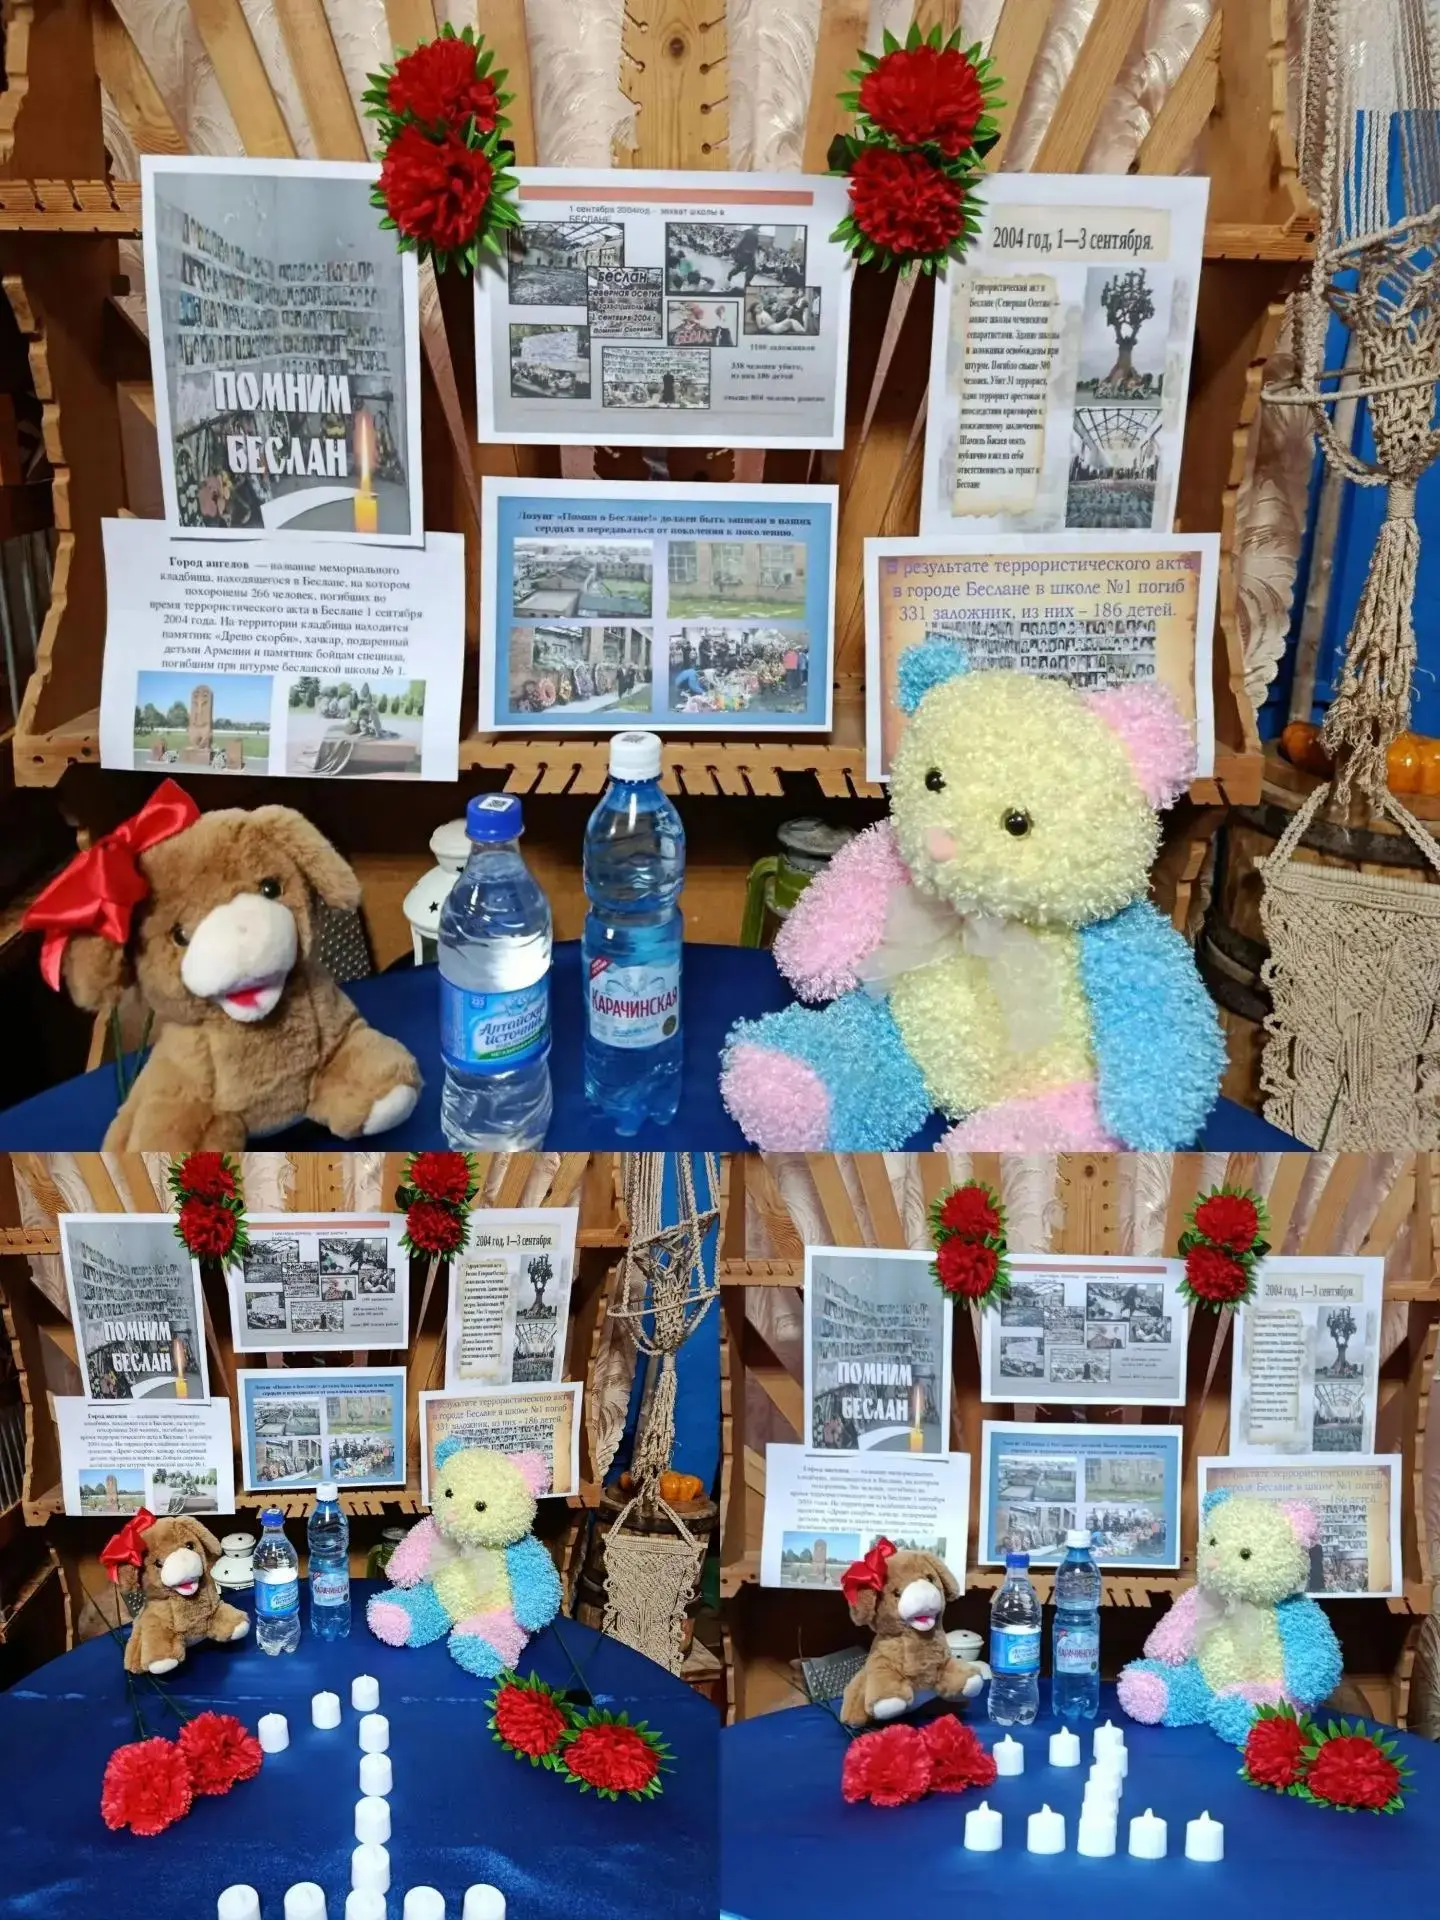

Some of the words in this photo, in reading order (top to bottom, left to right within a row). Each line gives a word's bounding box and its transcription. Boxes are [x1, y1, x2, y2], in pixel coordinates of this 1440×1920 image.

[993, 226, 1024, 249] 2004
[1027, 231, 1053, 252] год,
[1090, 228, 1154, 256] сентября.
[212, 370, 351, 415] ПОМНИМ
[226, 433, 348, 478] БЕСЛАН
[169, 556, 204, 570] Город
[206, 560, 250, 570] ангелов
[270, 562, 317, 572] название
[319, 564, 400, 576] мемориального
[903, 561, 990, 578] результате
[994, 558, 1151, 577] террористического
[1155, 558, 1196, 572] акта
[217, 575, 291, 586] находящегося
[351, 580, 363, 588] на
[365, 580, 411, 592] котором
[893, 586, 903, 599] в
[907, 585, 961, 601] городе
[966, 580, 1031, 598] Беслане
[1036, 583, 1046, 597] в
[1050, 582, 1101, 597] школе
[1106, 578, 1132, 596] №1
[1138, 576, 1186, 595] погиб
[185, 588, 248, 600] похоронены
[251, 588, 271, 599] 266
[320, 591, 371, 602] погибших
[374, 595, 387, 603] во
[149, 601, 181, 612] время
[183, 603, 284, 615] террористического
[286, 606, 310, 615] акта
[321, 605, 364, 617] Беслане
[375, 608, 423, 621] сентября
[898, 604, 927, 623] 331
[1021, 604, 1040, 620] из
[1044, 602, 1076, 619] них
[1093, 601, 1123, 618] 186
[1125, 600, 1178, 619] детей.
[163, 614, 189, 625] 2004
[220, 615, 235, 626] На
[237, 618, 298, 630] территории
[301, 620, 352, 632] кладбища
[355, 623, 409, 633] находится
[162, 630, 213, 641] памятник
[203, 645, 251, 658] Армении
[263, 648, 314, 660] памятник
[316, 648, 355, 661] бойцам
[162, 658, 215, 670] погибшим
[217, 662, 237, 672] при
[239, 662, 280, 674] штурме
[282, 661, 342, 675] бесланской
[344, 666, 380, 676] школы
[591, 985, 679, 1020] КАРАЧИНСКАЯ
[103, 1321, 172, 1342] ПОМНИМ
[111, 1352, 172, 1373] БЕСЛАН
[837, 1361, 912, 1387] ПОМНИМ
[841, 1397, 909, 1422] БЕСЛАН
